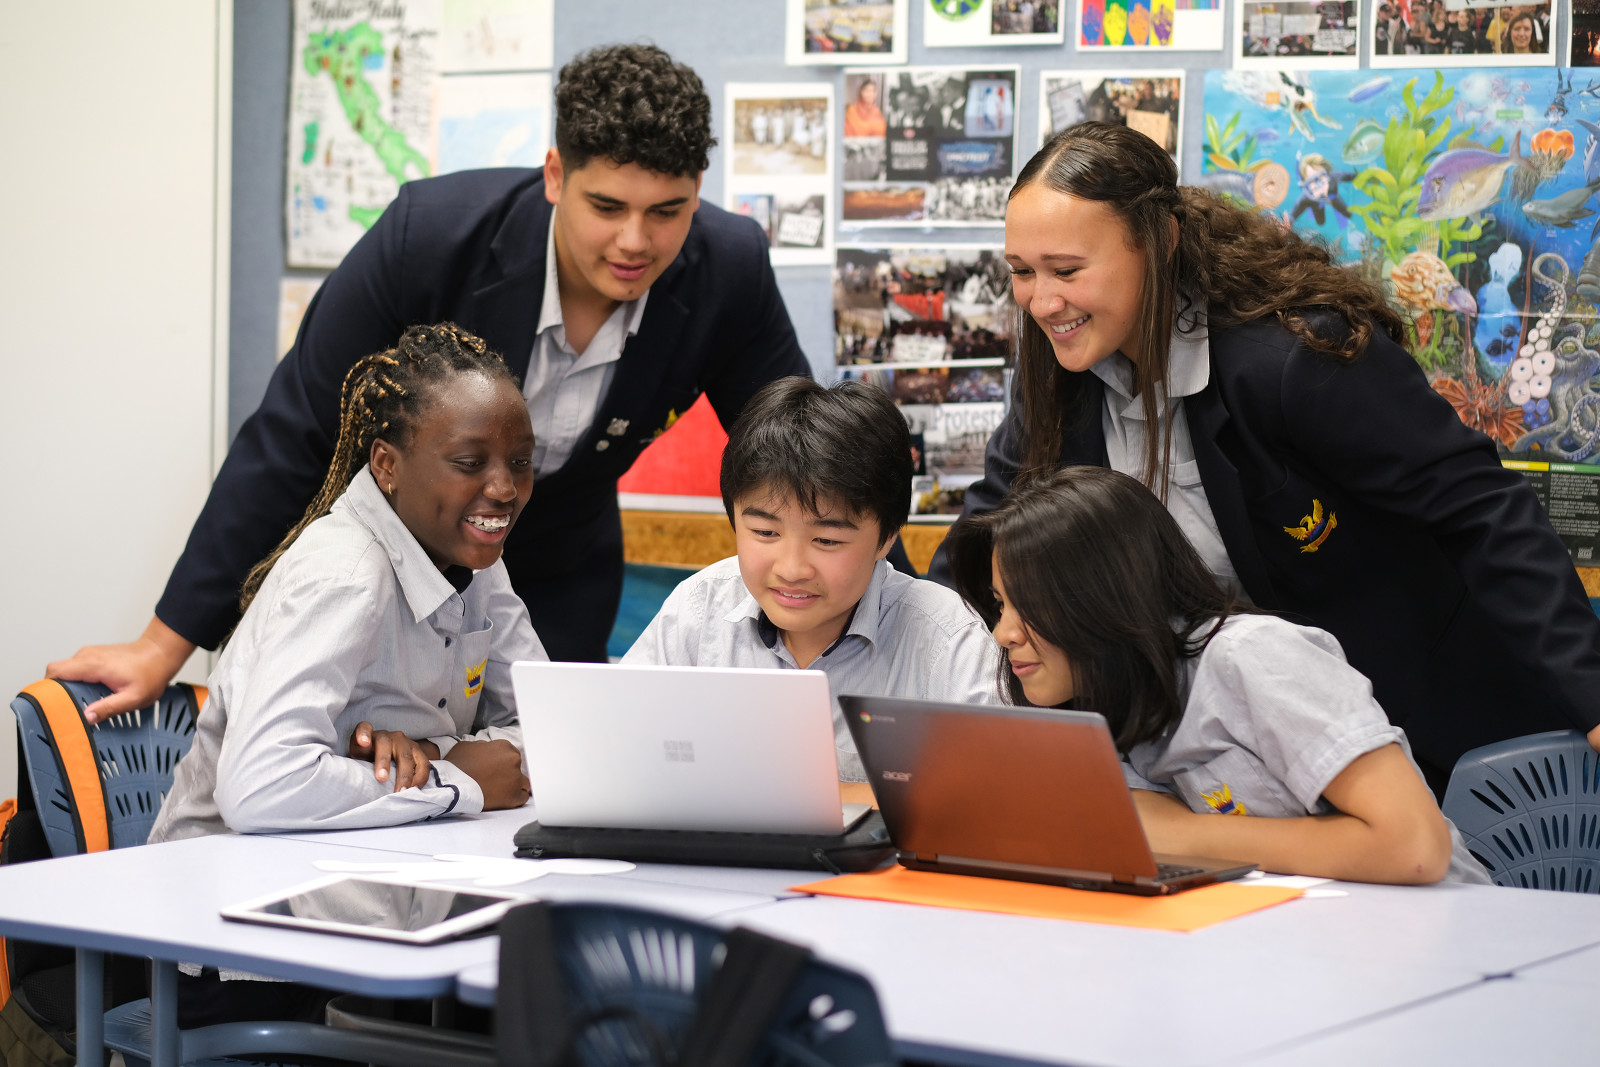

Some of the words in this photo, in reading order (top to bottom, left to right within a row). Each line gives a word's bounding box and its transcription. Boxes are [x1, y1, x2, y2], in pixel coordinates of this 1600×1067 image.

[931, 404, 1005, 432] Protests
[1551, 464, 1576, 472] SPAWNING
[882, 771, 912, 782] acer
